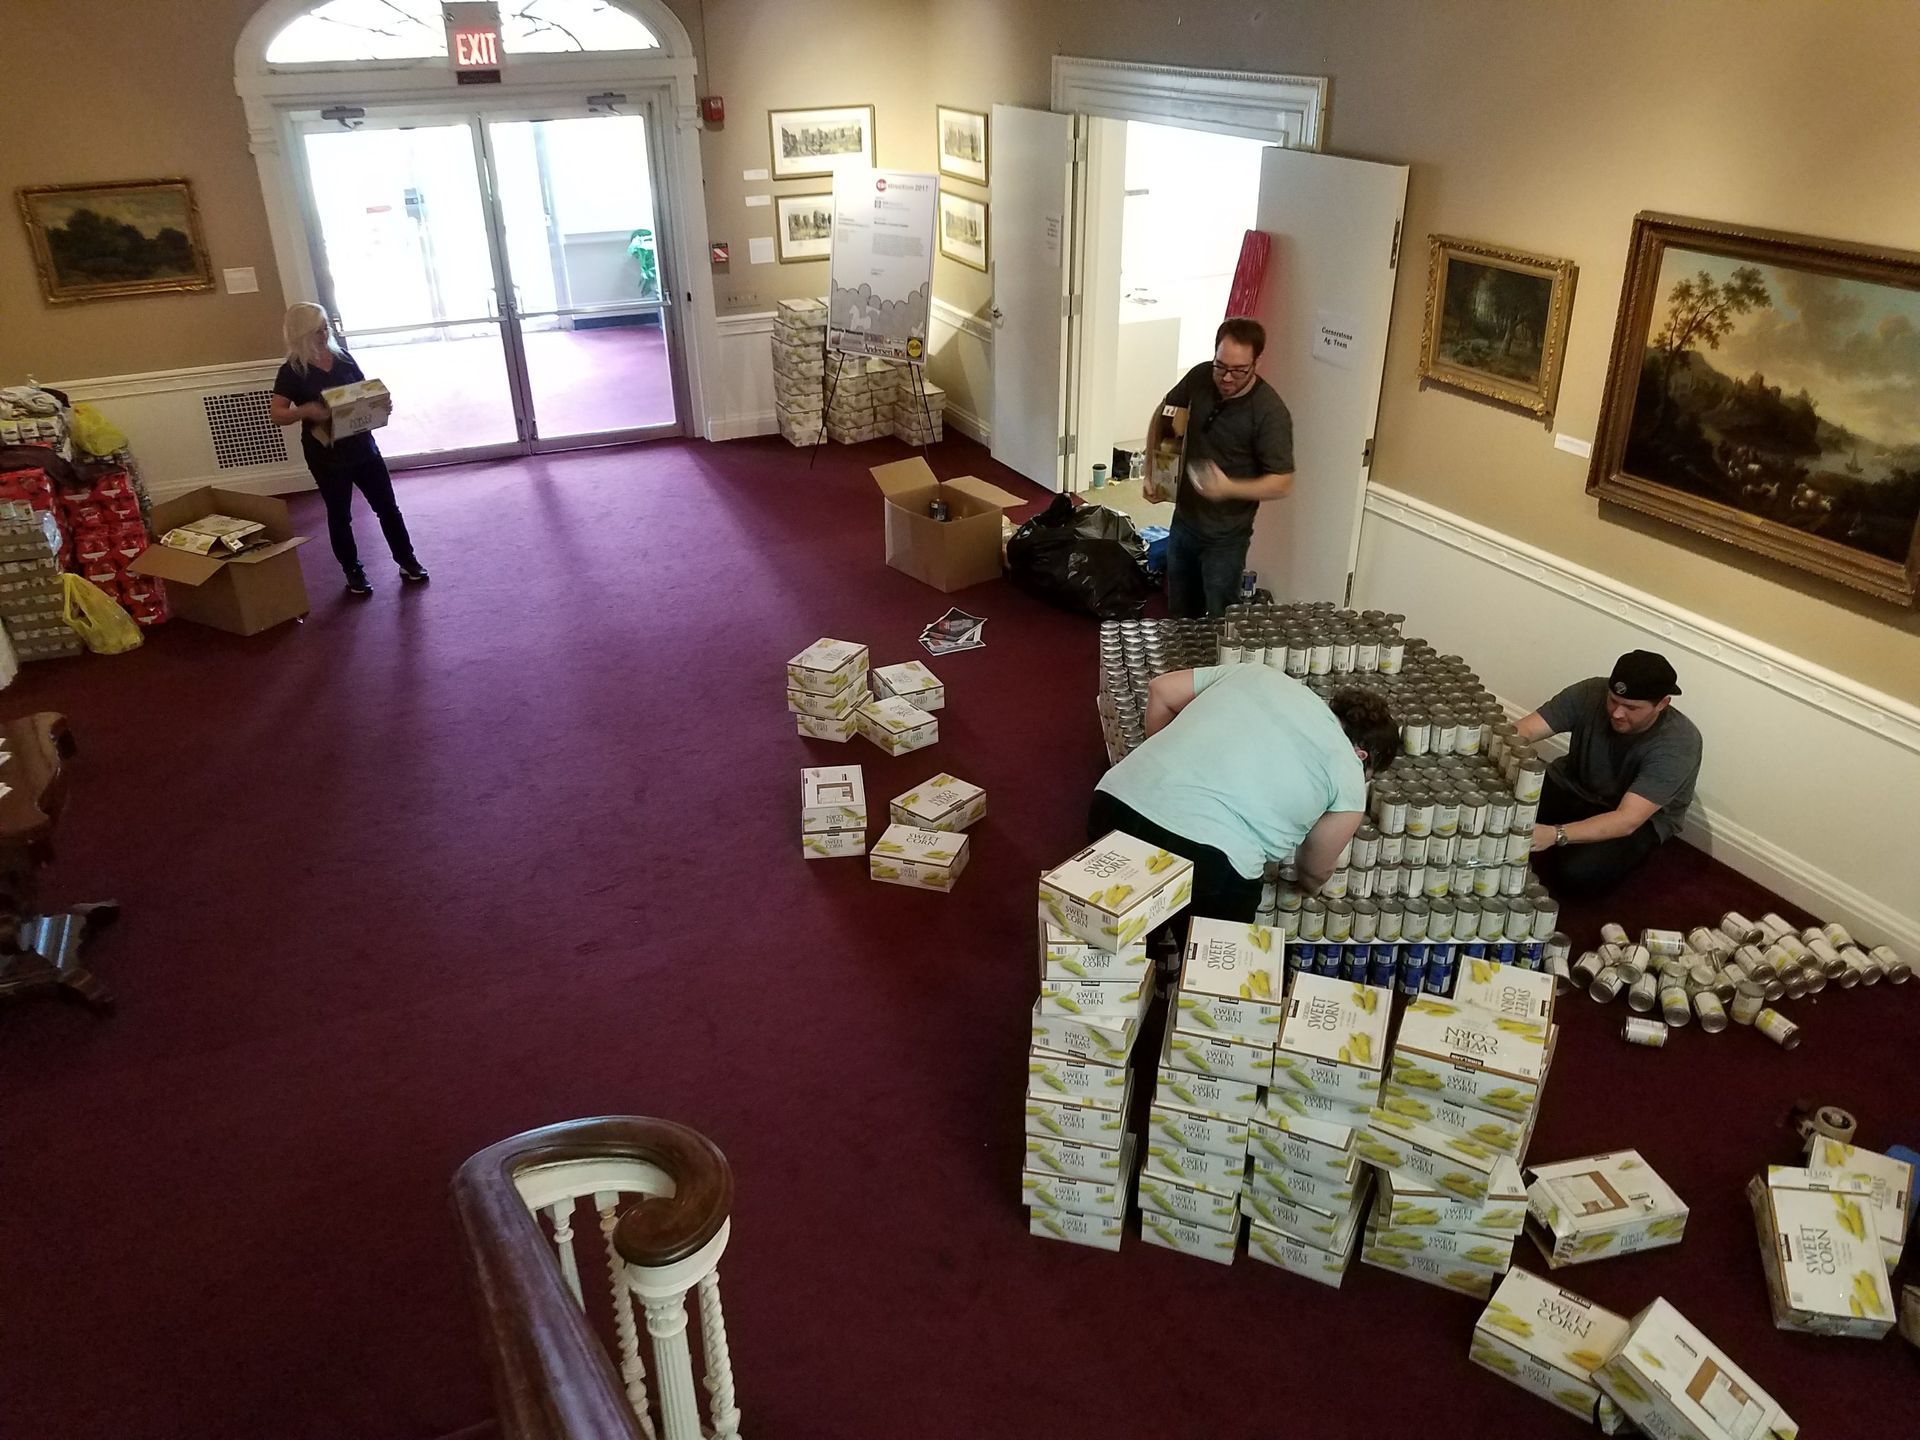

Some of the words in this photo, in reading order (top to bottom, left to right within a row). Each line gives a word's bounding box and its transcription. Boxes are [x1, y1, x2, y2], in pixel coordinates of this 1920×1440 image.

[456, 32, 497, 65] EXIT
[915, 184, 929, 192] 2017
[864, 343, 893, 356] Andersen
[906, 838, 936, 846] CORN
[908, 833, 940, 842] SWEET
[1083, 850, 1121, 875] SWEET
[1096, 855, 1132, 879] CORN
[1065, 905, 1089, 921] SWEET
[1065, 912, 1089, 929] CORN
[1082, 954, 1112, 962] SWEET
[1207, 938, 1224, 970] SWEET
[1221, 940, 1237, 971] CORN
[1082, 960, 1111, 968] CORN
[1500, 986, 1517, 1015] CORN
[1514, 988, 1531, 1018] SWEET
[1213, 1006, 1242, 1018] SWEET
[1307, 996, 1326, 1030] SWEET
[1322, 1000, 1341, 1031] CORN
[1213, 1014, 1242, 1024] CORN
[1064, 1031, 1090, 1043] CORN
[1446, 1026, 1498, 1046] CORN
[1065, 1038, 1091, 1049] SWEET
[1440, 1034, 1498, 1055] SWEET
[1205, 1049, 1234, 1061] SWEET
[1206, 1057, 1234, 1067] CORN
[1062, 1071, 1089, 1081] SWEET
[1311, 1068, 1341, 1080] SWEET
[1063, 1078, 1089, 1087] CORN
[1311, 1076, 1340, 1087] CORN
[1447, 1075, 1479, 1090] SWEET
[1192, 1084, 1220, 1096] SWEET
[1447, 1081, 1477, 1095] CORN
[1192, 1090, 1220, 1100] CORN
[1304, 1095, 1333, 1107] SWEET
[1304, 1100, 1332, 1111] CORN
[1058, 1112, 1085, 1123] SWEET
[1436, 1107, 1467, 1122] SWEET
[1436, 1113, 1465, 1128] CORN
[1058, 1120, 1085, 1129] CORN
[1183, 1123, 1211, 1135] SWEET
[1183, 1131, 1211, 1141] CORN
[1406, 1153, 1435, 1168] SWEET
[1405, 1160, 1433, 1175] CORN
[1443, 1207, 1473, 1215] SWEET
[1443, 1213, 1473, 1221] CORN
[1800, 1223, 1822, 1275] SWEET
[1815, 1227, 1836, 1275] CORN
[1541, 1298, 1596, 1329] SWEET
[1537, 1308, 1588, 1338] CORN
